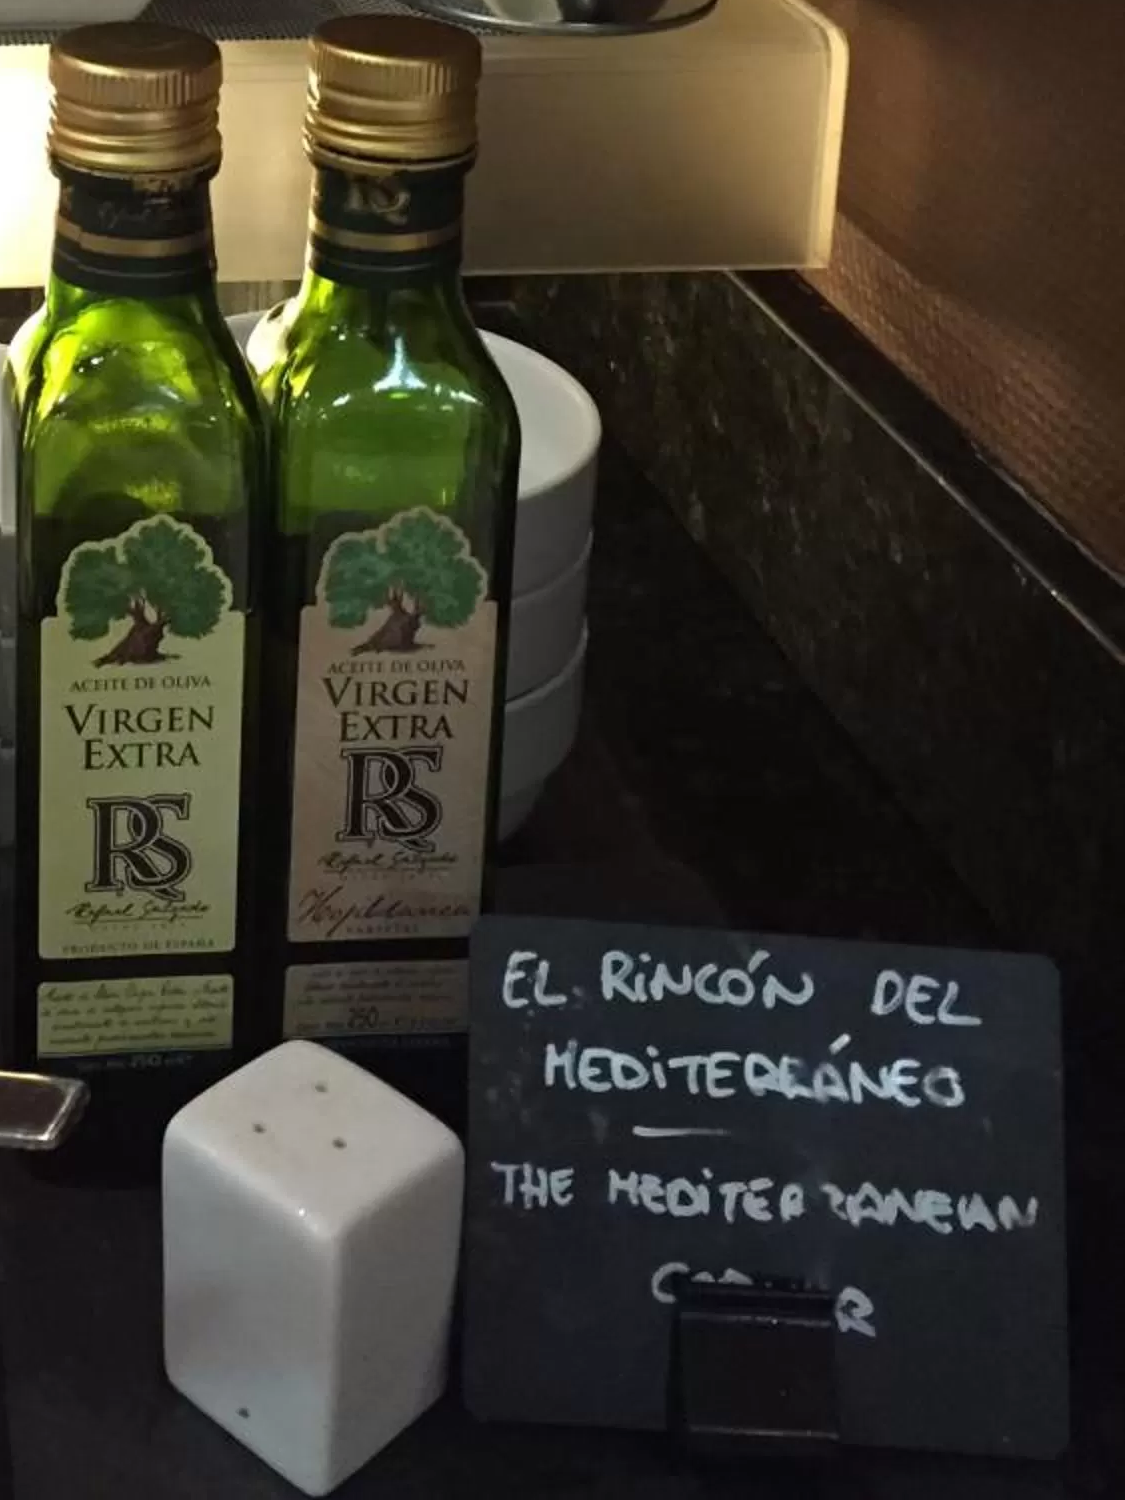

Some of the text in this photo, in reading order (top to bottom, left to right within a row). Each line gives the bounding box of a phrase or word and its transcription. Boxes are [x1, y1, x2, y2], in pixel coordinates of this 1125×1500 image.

[416, 659, 466, 673] OLIVA
[69, 675, 211, 693] ACEITE DE OLIVA
[322, 676, 469, 708] VIRGEN
[63, 703, 215, 736] VIRGEN
[339, 711, 454, 742] EXTRA
[83, 738, 201, 771] EXTRA
[502, 951, 567, 1007] EL
[871, 970, 982, 1026] DEL
[491, 1161, 574, 1209] THE
